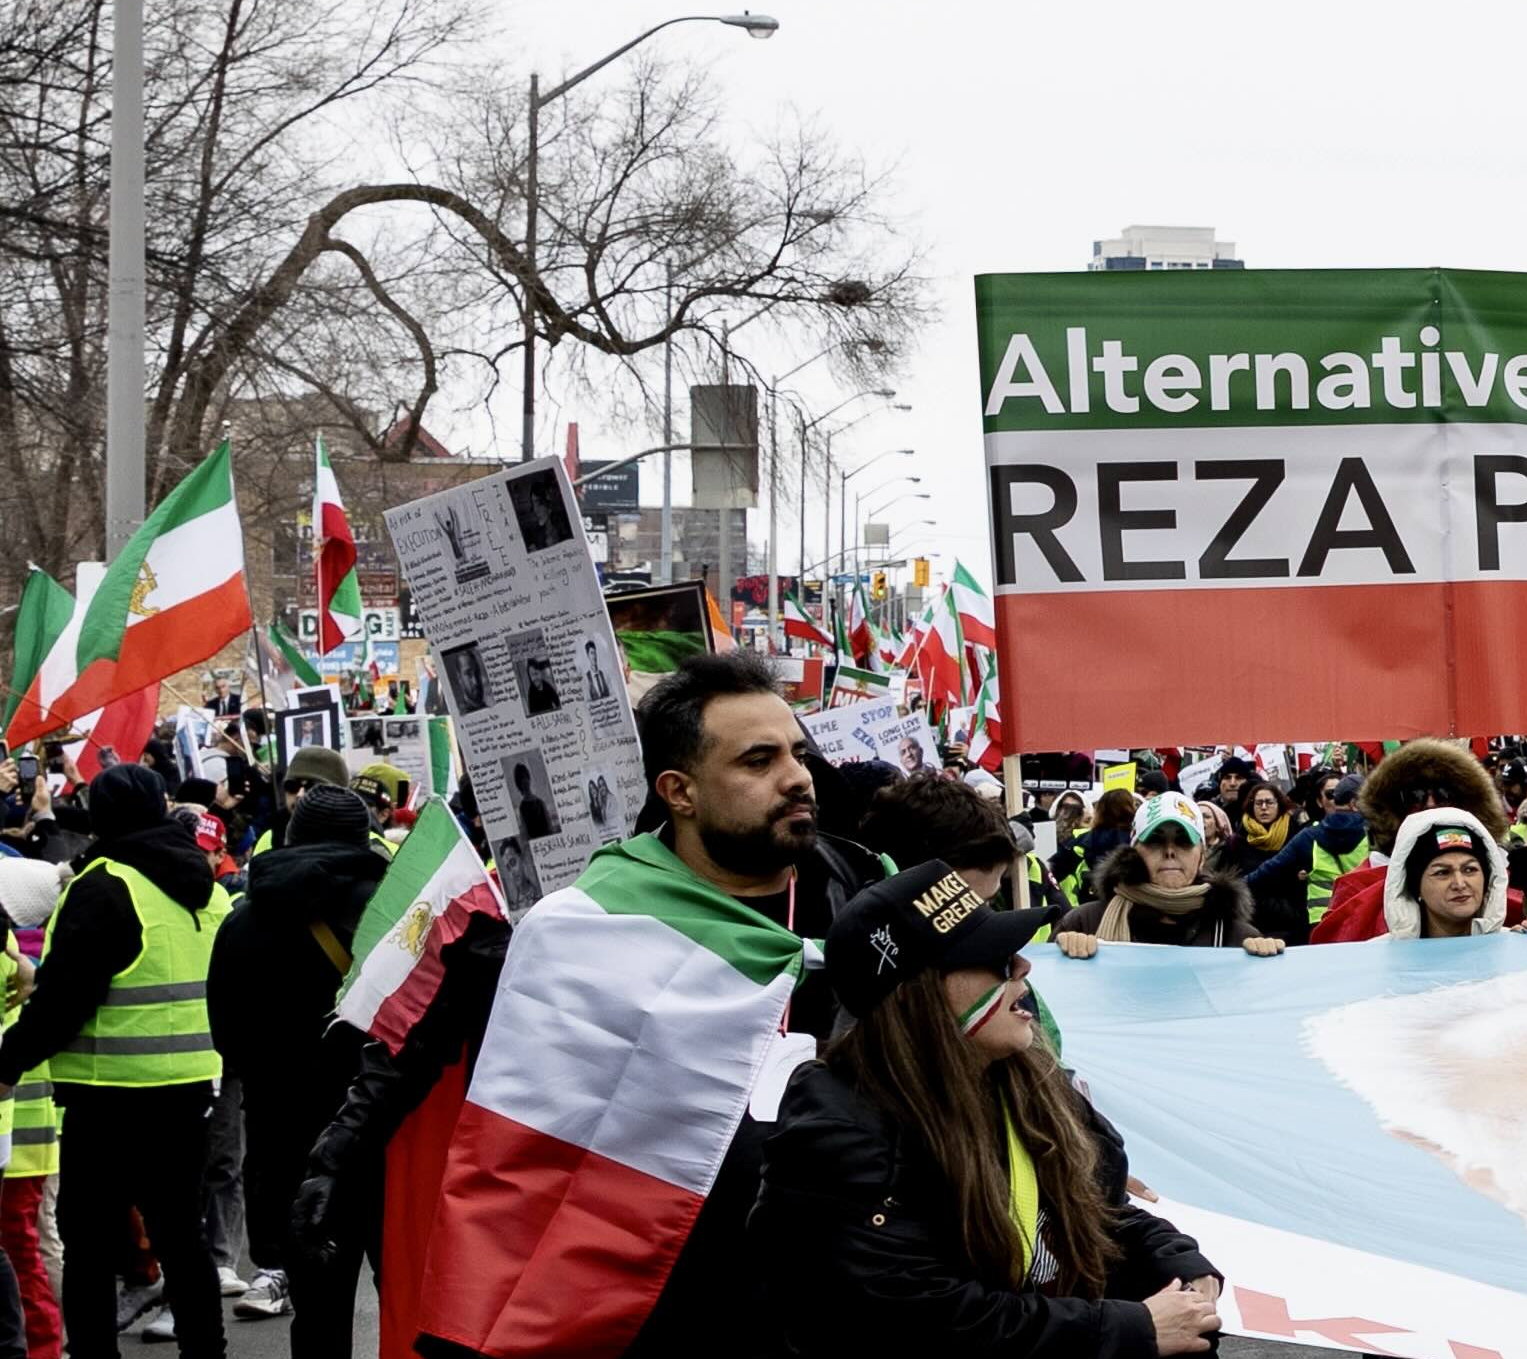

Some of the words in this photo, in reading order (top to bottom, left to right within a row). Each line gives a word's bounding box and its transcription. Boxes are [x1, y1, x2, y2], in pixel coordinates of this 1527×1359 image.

[988, 457, 1417, 586] REZA
[396, 526, 445, 556] EXECUTION
[860, 705, 893, 725] STOP
[912, 873, 965, 918] MAKE
